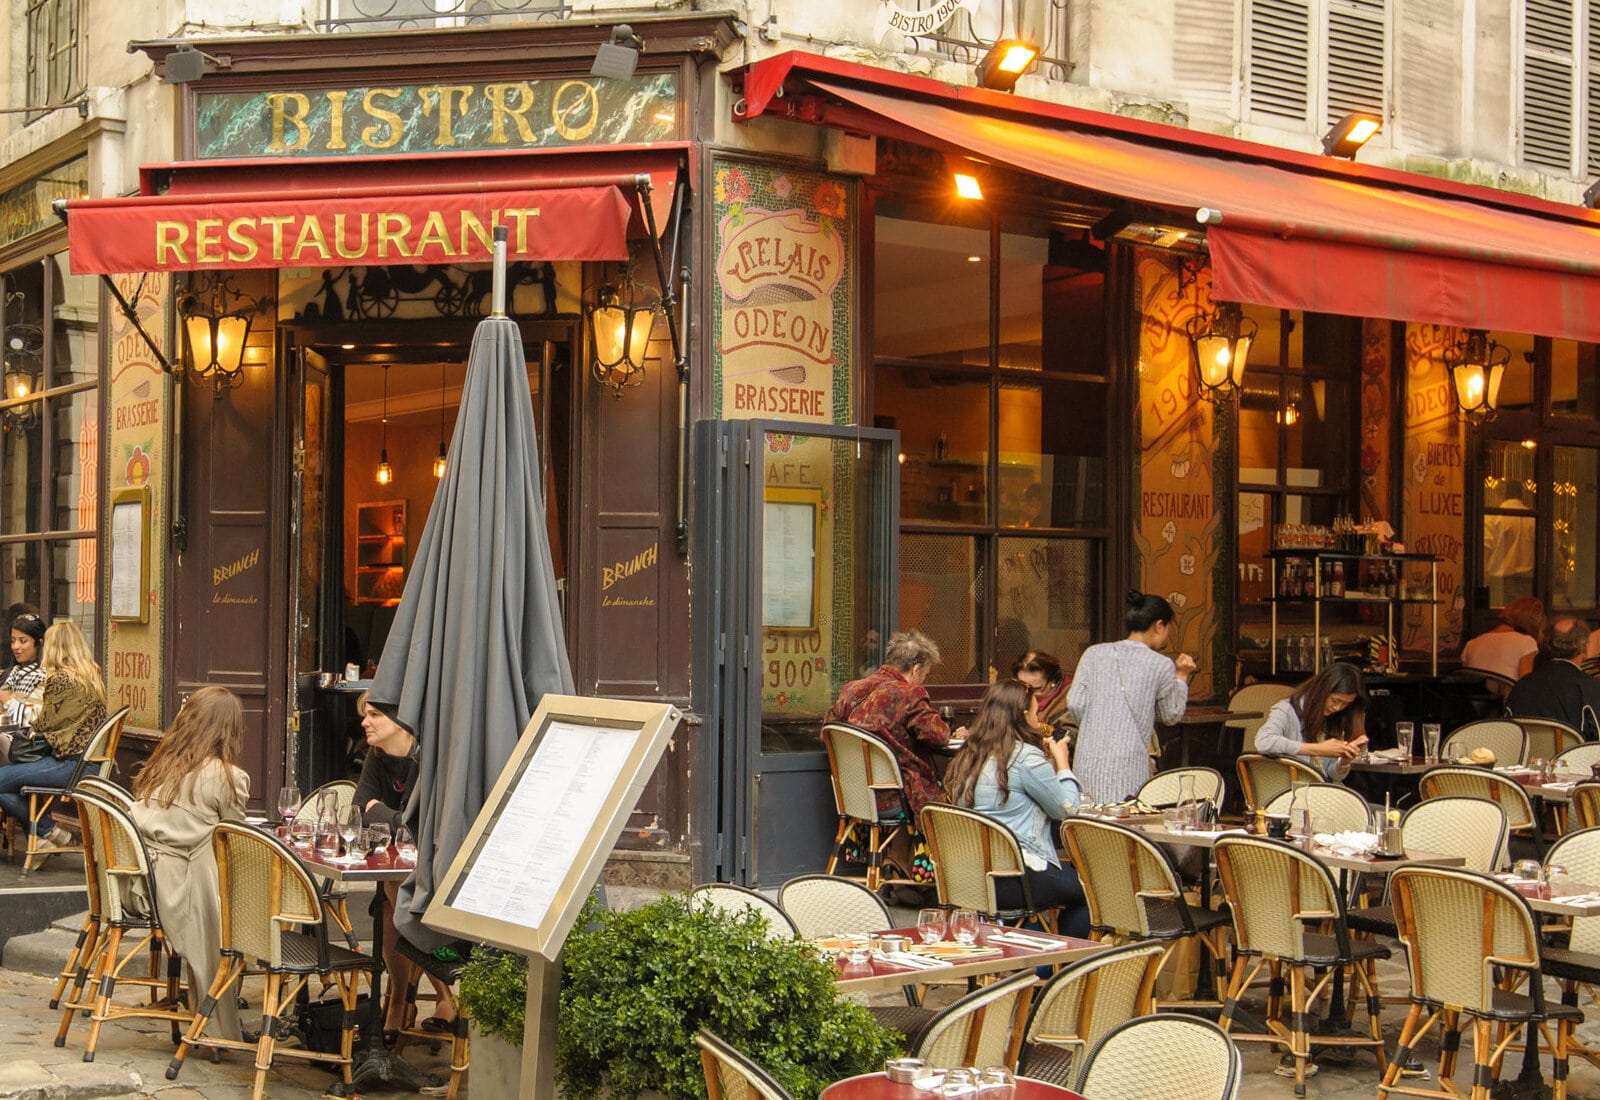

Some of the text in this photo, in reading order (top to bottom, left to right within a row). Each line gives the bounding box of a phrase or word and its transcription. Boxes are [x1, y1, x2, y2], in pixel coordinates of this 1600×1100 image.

[888, 10, 934, 34] BISTRO
[267, 80, 599, 152] BISTRO
[154, 207, 541, 266] RESTAURANT
[727, 237, 831, 283] RELAIS
[734, 308, 830, 353] ODEON
[735, 383, 825, 416] BRASSERIE
[116, 399, 159, 431] BRASSERIE
[767, 463, 810, 484] AFE
[1433, 472, 1446, 487] de
[1143, 492, 1211, 520] RESTAURANT
[1419, 491, 1462, 518] LUXE
[213, 547, 260, 586] BRUNCH
[602, 542, 658, 591] BRUNCH
[612, 596, 656, 606] dimanche
[765, 631, 821, 653] STRO
[114, 652, 151, 679] BISTRO
[761, 660, 812, 688] 900
[118, 684, 147, 712] 1900
